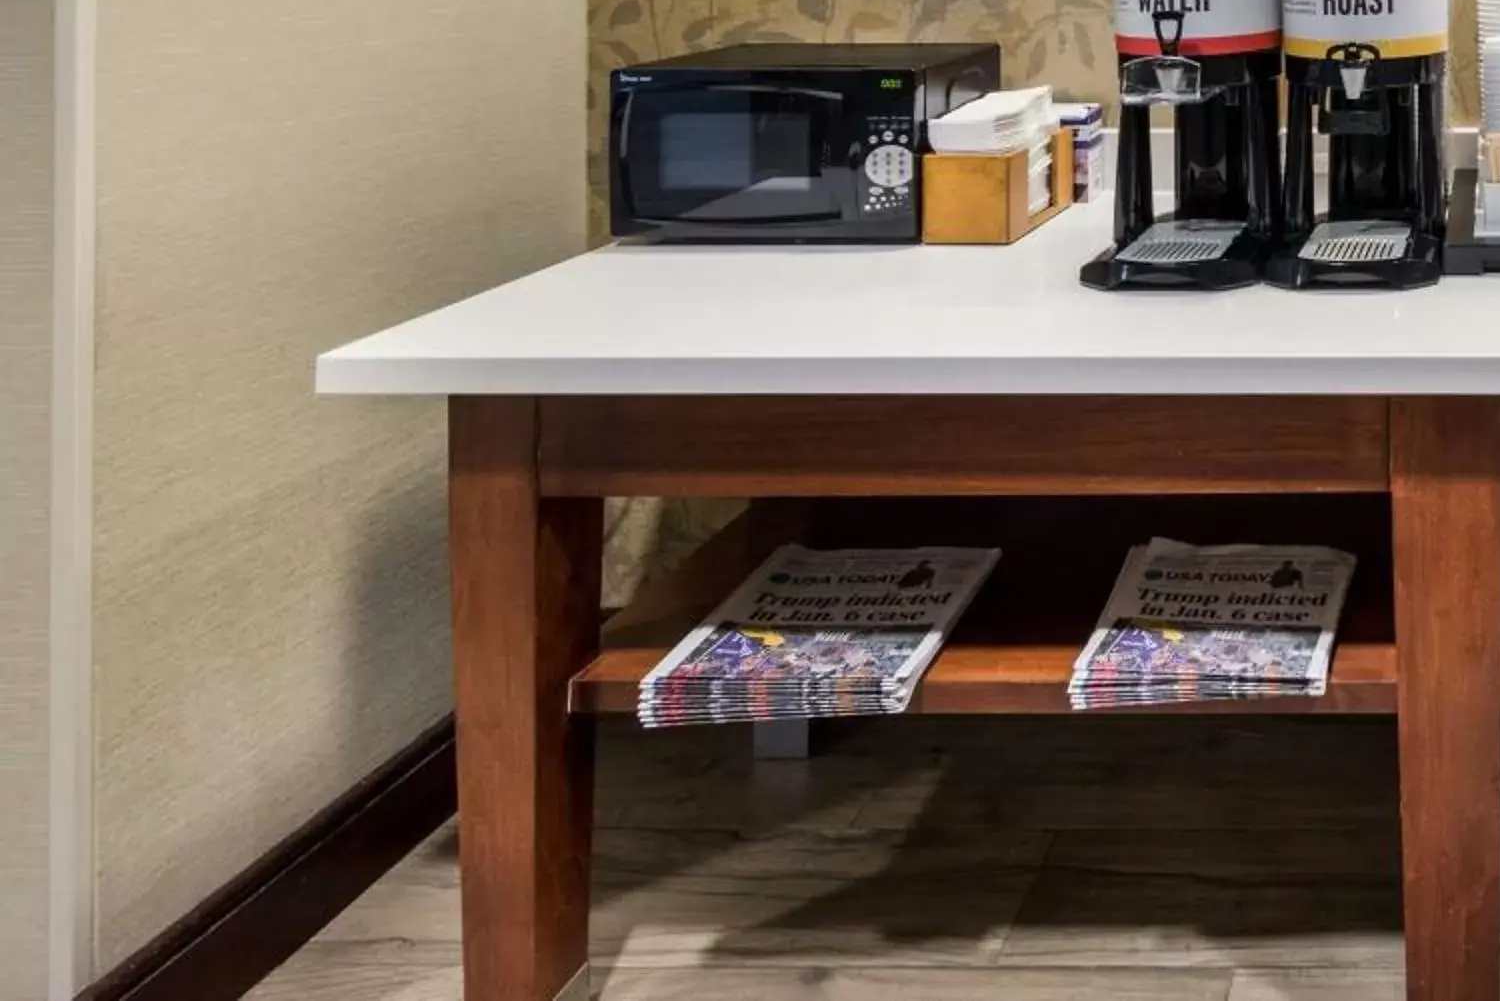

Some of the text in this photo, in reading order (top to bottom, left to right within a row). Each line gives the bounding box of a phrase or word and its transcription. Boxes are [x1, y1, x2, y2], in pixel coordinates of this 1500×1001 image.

[791, 573, 831, 585] USA
[1165, 570, 1203, 582] USA
[753, 590, 953, 610] Trump indicted
[1137, 587, 1329, 607] Trump indicted
[748, 607, 926, 622] in Jan. 6 case
[1138, 603, 1311, 623] in Jan. 6 case
